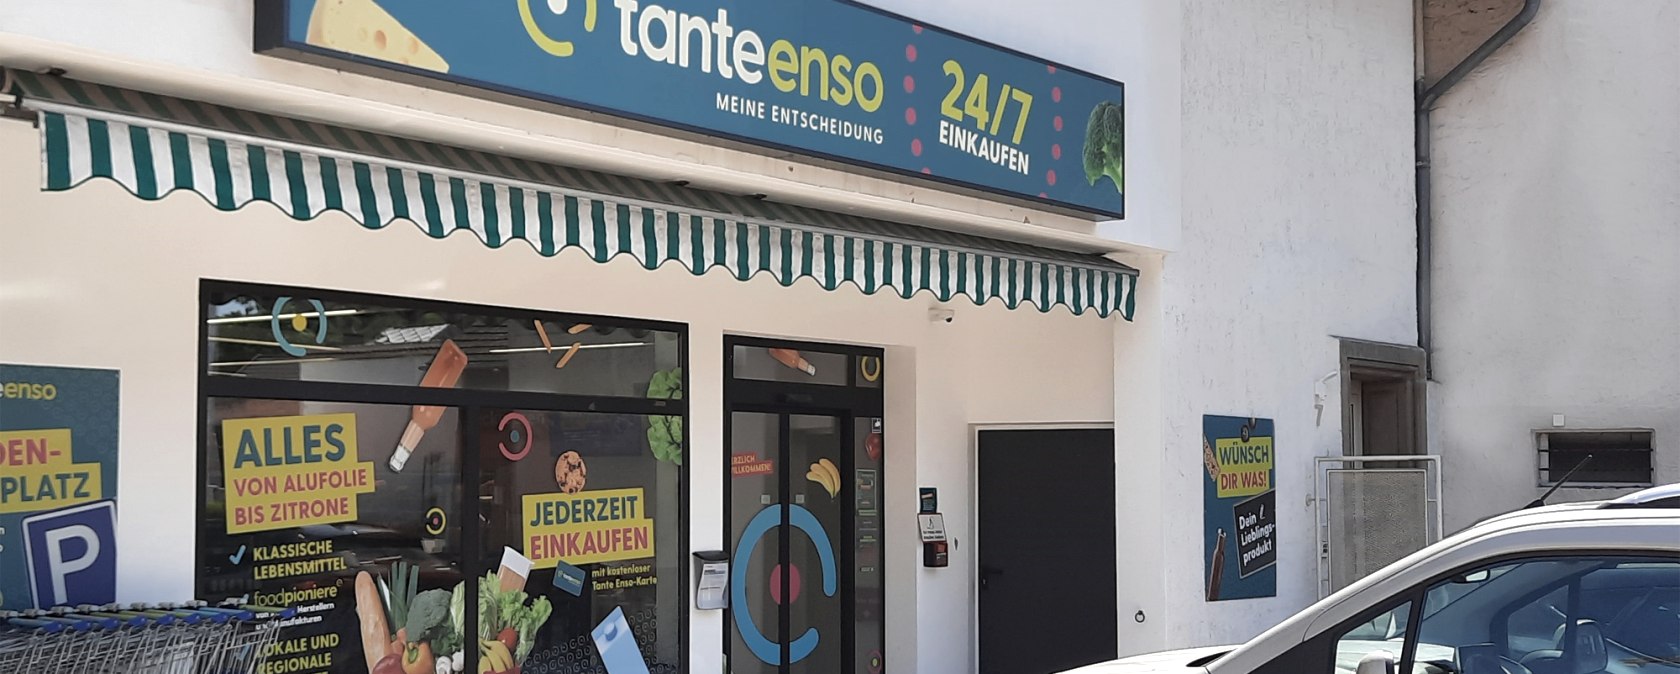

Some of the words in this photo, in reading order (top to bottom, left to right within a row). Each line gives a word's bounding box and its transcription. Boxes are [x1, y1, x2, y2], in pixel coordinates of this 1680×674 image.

[613, 0, 884, 113] tanteenso
[941, 59, 1033, 145] 24/7
[716, 92, 765, 119] MEINE
[771, 105, 884, 145] ENTSCHEIDUNG
[939, 119, 1029, 175] EINKAUFEN
[1314, 404, 1324, 428] 7
[233, 423, 346, 469] ALLES
[1219, 442, 1269, 466] WÜNSCH
[0, 472, 91, 503] PLATZ
[233, 476, 277, 497] VON
[284, 469, 367, 493] ALUFOLIE
[1221, 473, 1238, 491] DIR
[1240, 470, 1267, 489] WAS!
[234, 505, 264, 526] BIS
[270, 497, 349, 522] ZITRONE
[530, 496, 638, 527] JEDERZEIT
[1239, 512, 1257, 529] Dein
[530, 526, 648, 560] EINKAUFEN
[1241, 523, 1275, 546] Lieblings-
[45, 524, 100, 605] P
[253, 540, 333, 561] KLASSISCHE
[1242, 539, 1272, 567] produkt
[254, 557, 347, 580] LEBENSMITTEL
[592, 567, 605, 578] mit
[607, 563, 651, 576] kostenloser
[592, 580, 614, 591] Tante
[615, 576, 657, 588] Enso-Karte
[310, 633, 339, 650] UND
